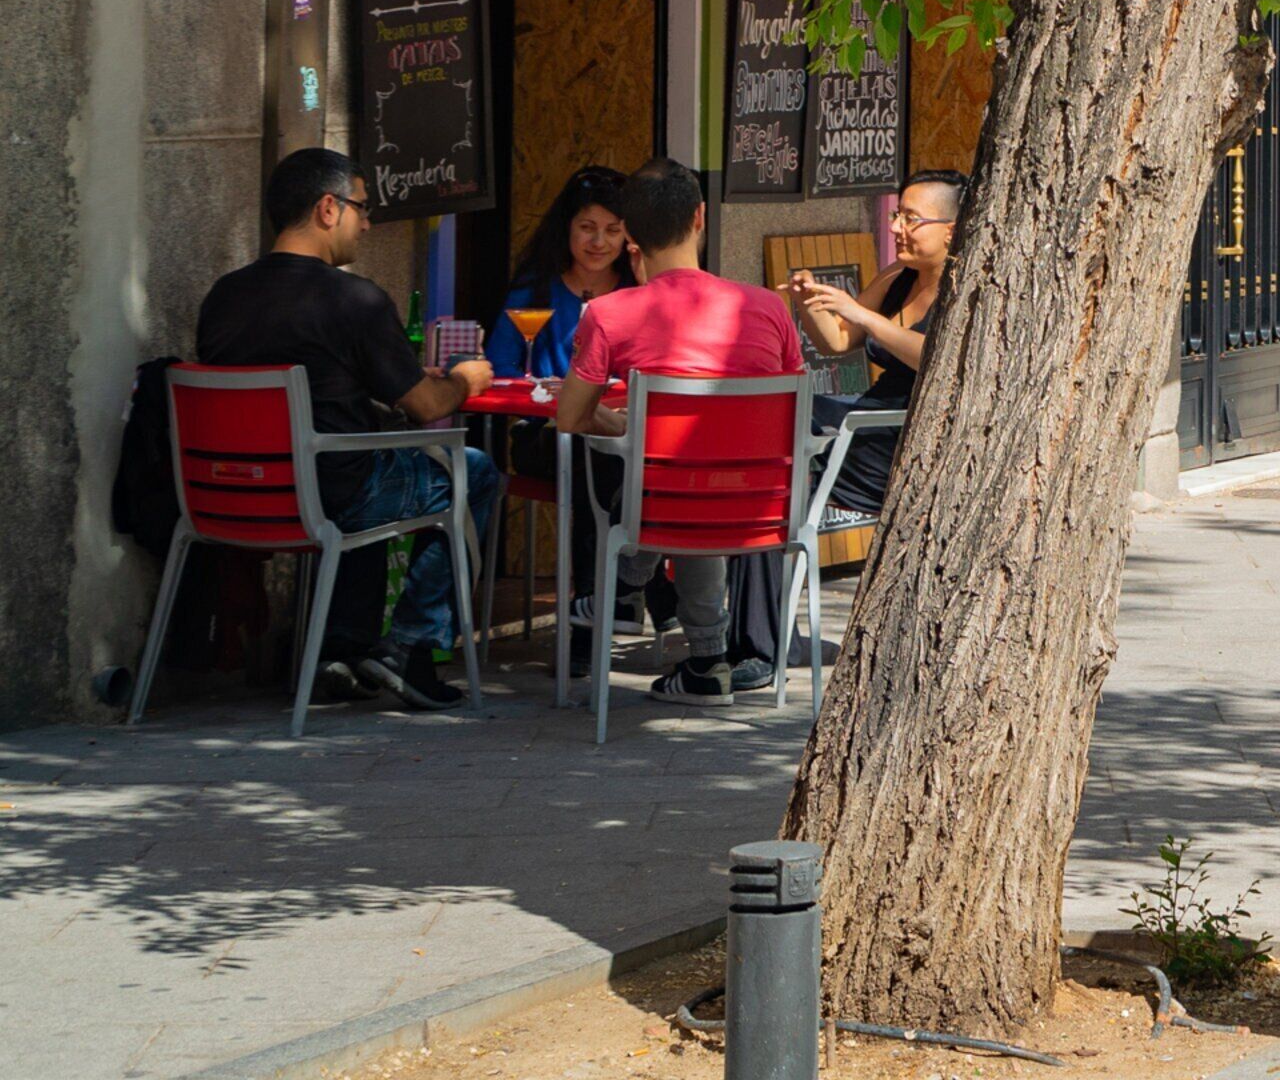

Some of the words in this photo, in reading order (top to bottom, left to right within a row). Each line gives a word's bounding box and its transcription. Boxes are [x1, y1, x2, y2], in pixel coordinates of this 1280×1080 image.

[819, 75, 897, 102] CHELAS
[816, 99, 898, 130] Micheladas
[820, 129, 895, 157] JARRITOS
